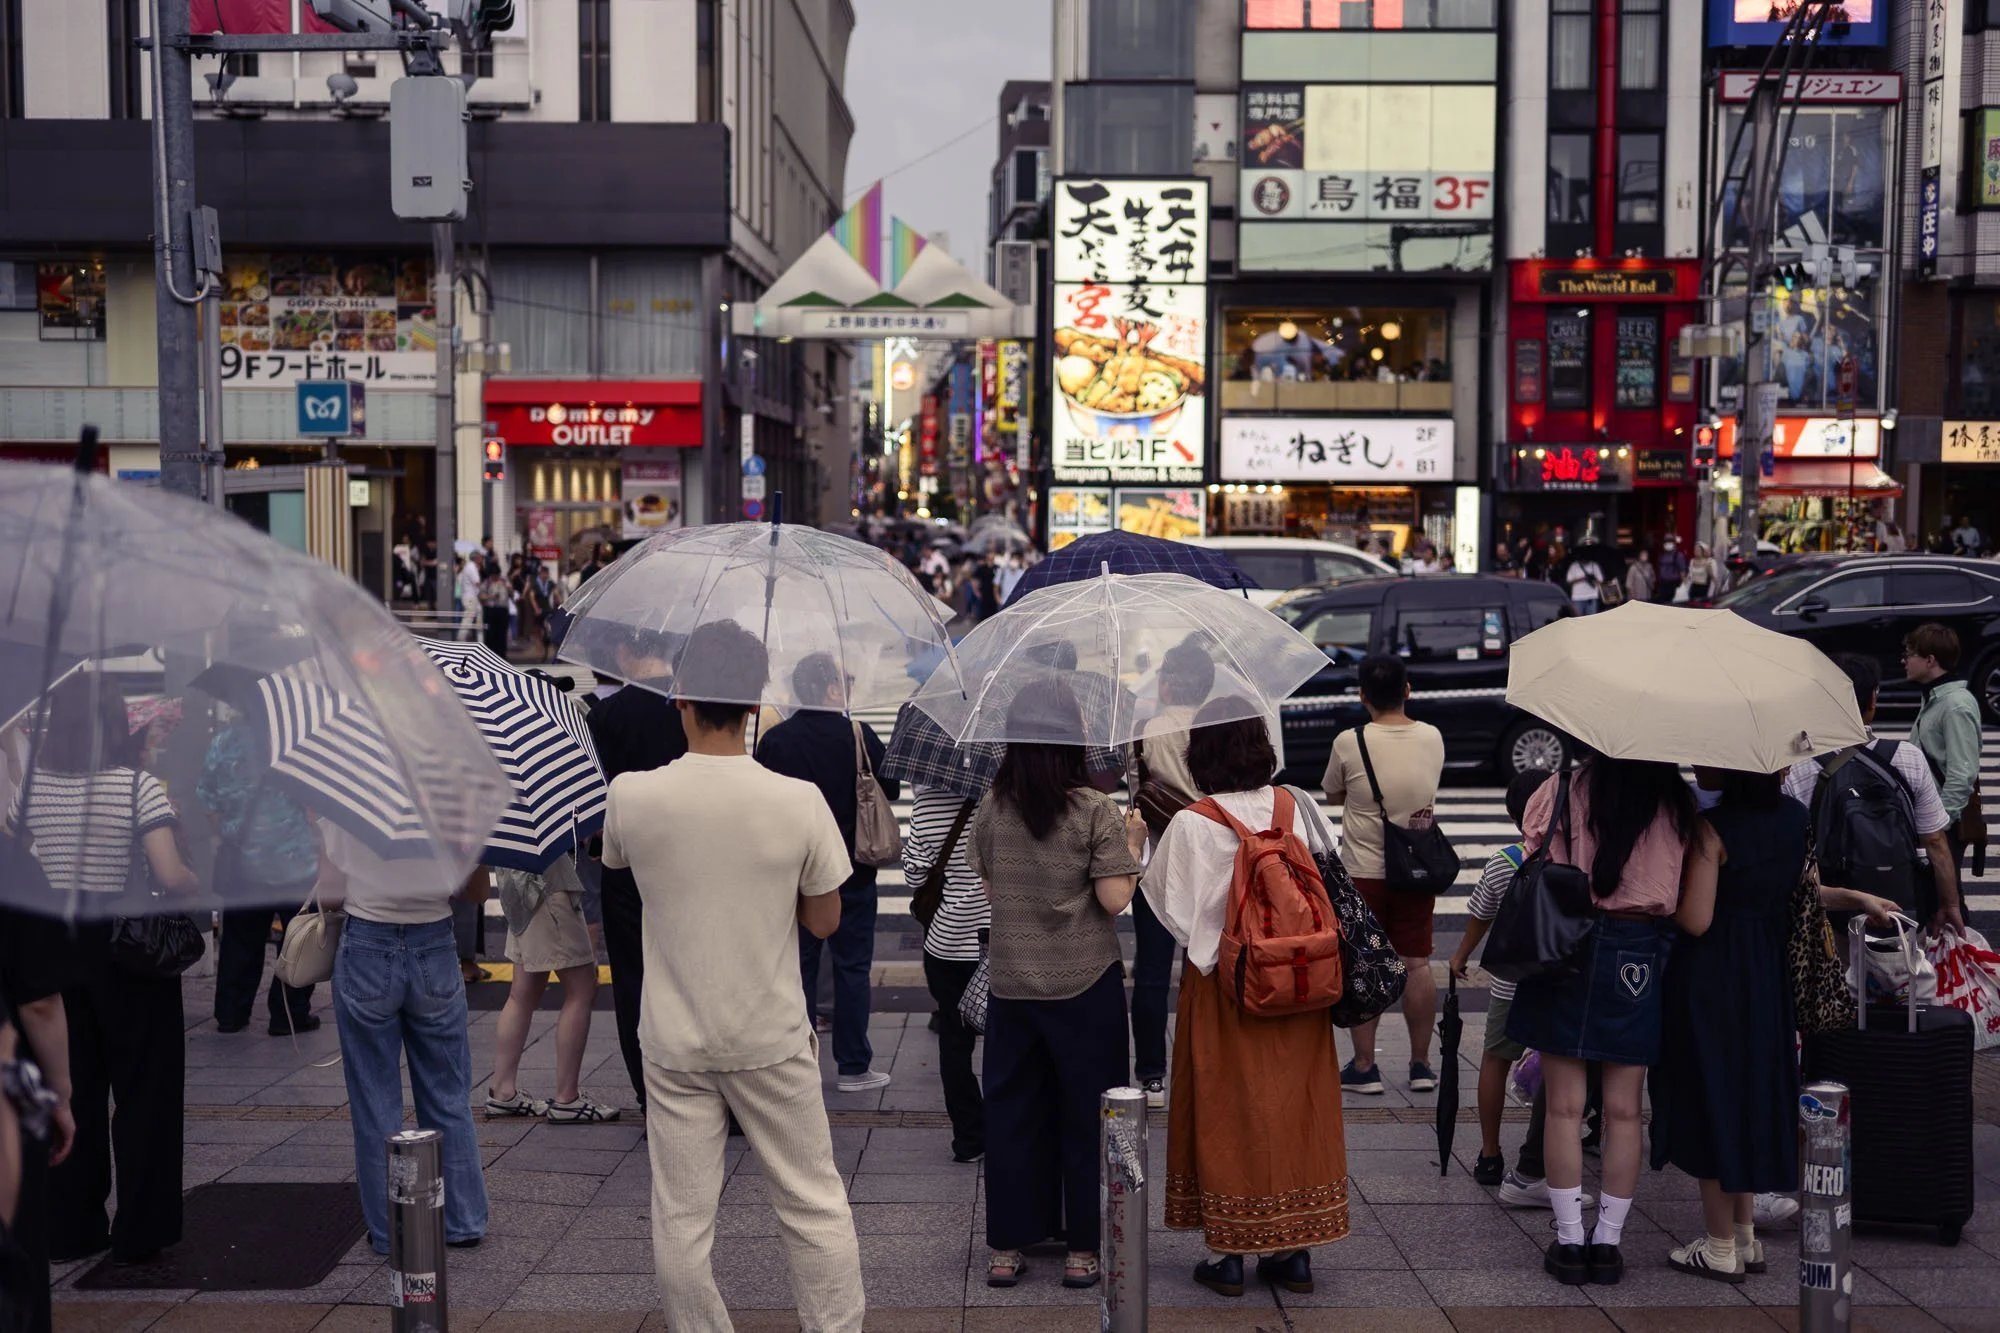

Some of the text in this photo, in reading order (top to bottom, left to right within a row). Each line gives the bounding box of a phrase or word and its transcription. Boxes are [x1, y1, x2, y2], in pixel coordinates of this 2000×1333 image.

[1309, 175, 1490, 212] 鳥福 3F
[1559, 279, 1657, 293] The World End
[1067, 276, 1112, 330] 宮
[1619, 319, 1654, 337] BEER
[551, 424, 634, 447] OUTLET
[1416, 426, 1438, 441] 2F
[1287, 431, 1394, 470] ねぎし
[1416, 460, 1437, 474] B1
[1804, 1162, 1844, 1197] NERO
